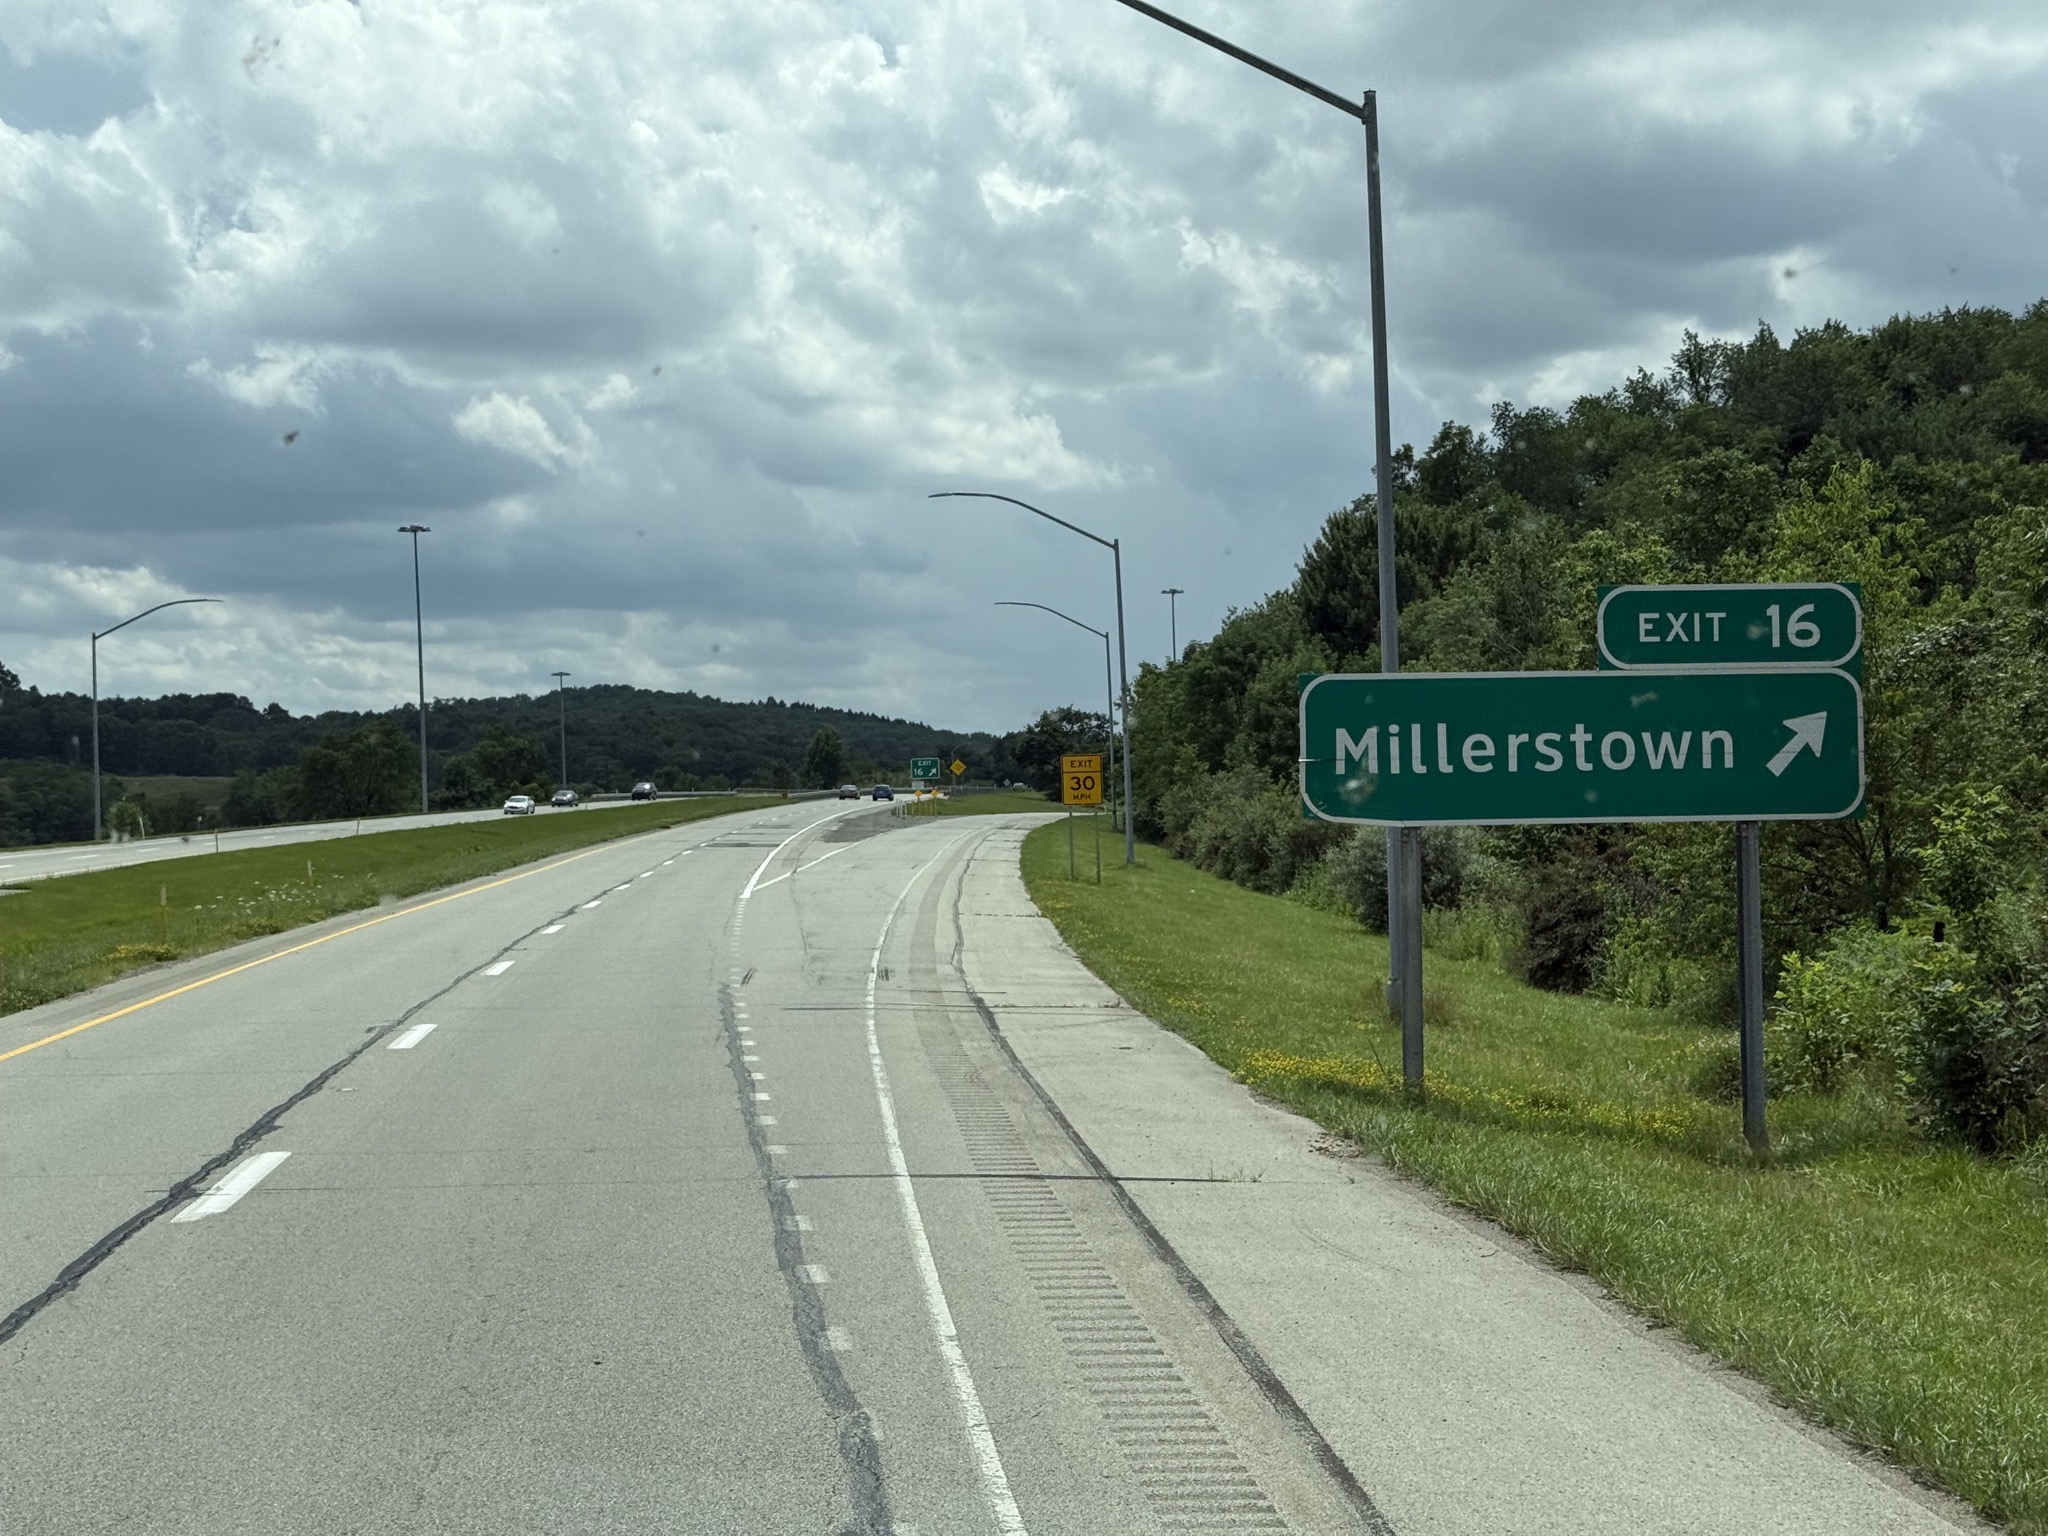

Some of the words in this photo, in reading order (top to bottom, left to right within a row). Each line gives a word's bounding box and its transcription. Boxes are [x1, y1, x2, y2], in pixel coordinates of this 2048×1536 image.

[1638, 612, 1727, 643] EXIT
[1766, 604, 1821, 648] 16
[1335, 723, 1735, 775] Millerstown
[1070, 760, 1093, 768] EXIT
[1070, 776, 1095, 791] 30
